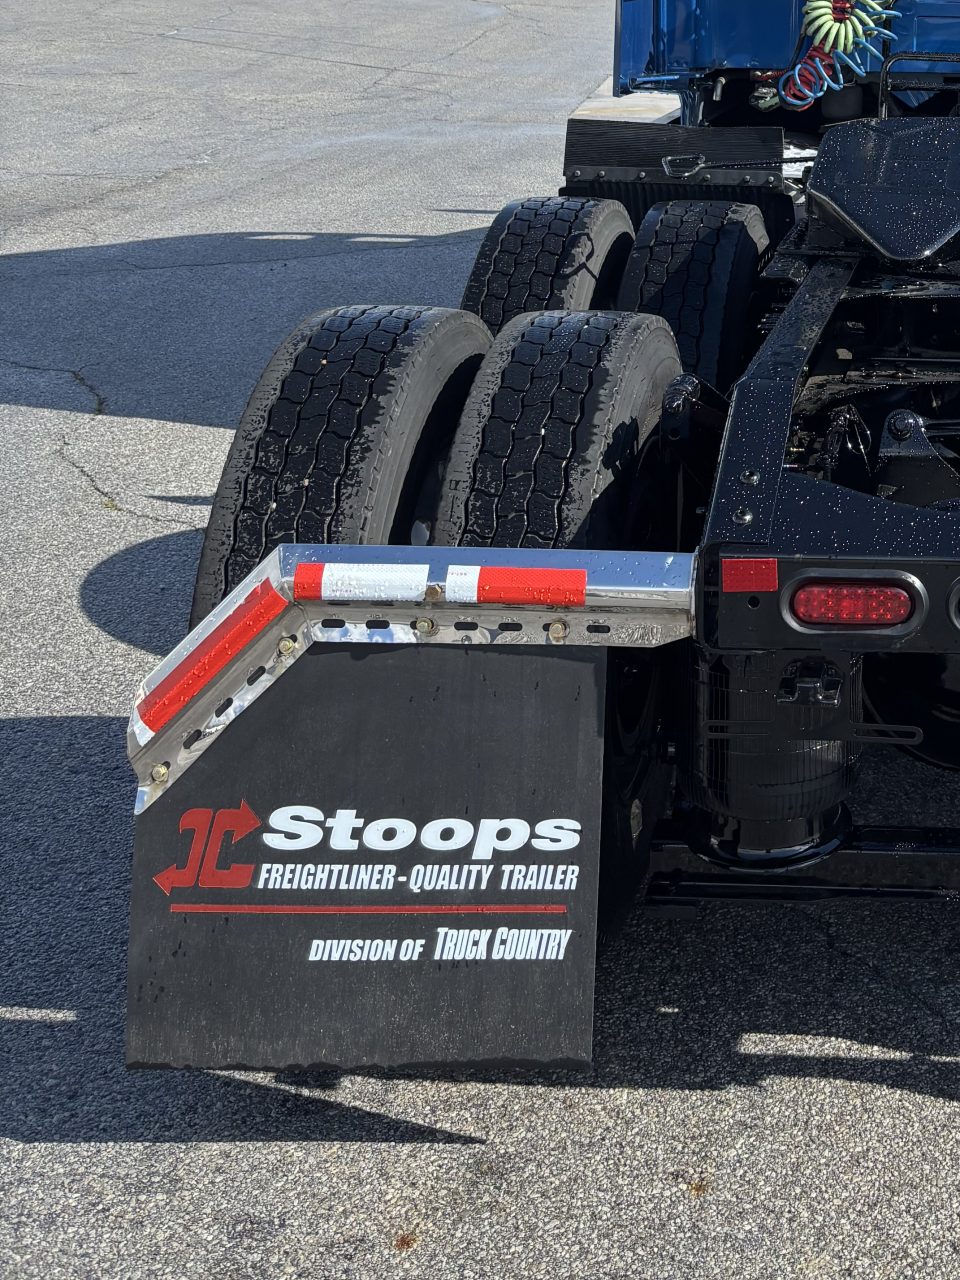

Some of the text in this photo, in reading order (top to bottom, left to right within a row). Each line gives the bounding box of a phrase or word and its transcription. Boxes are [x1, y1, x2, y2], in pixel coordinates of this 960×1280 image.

[262, 804, 583, 860] Stoops
[500, 863, 581, 891] TRAILER
[308, 926, 573, 961] DIVISION OF TRUCK COUNTRY
